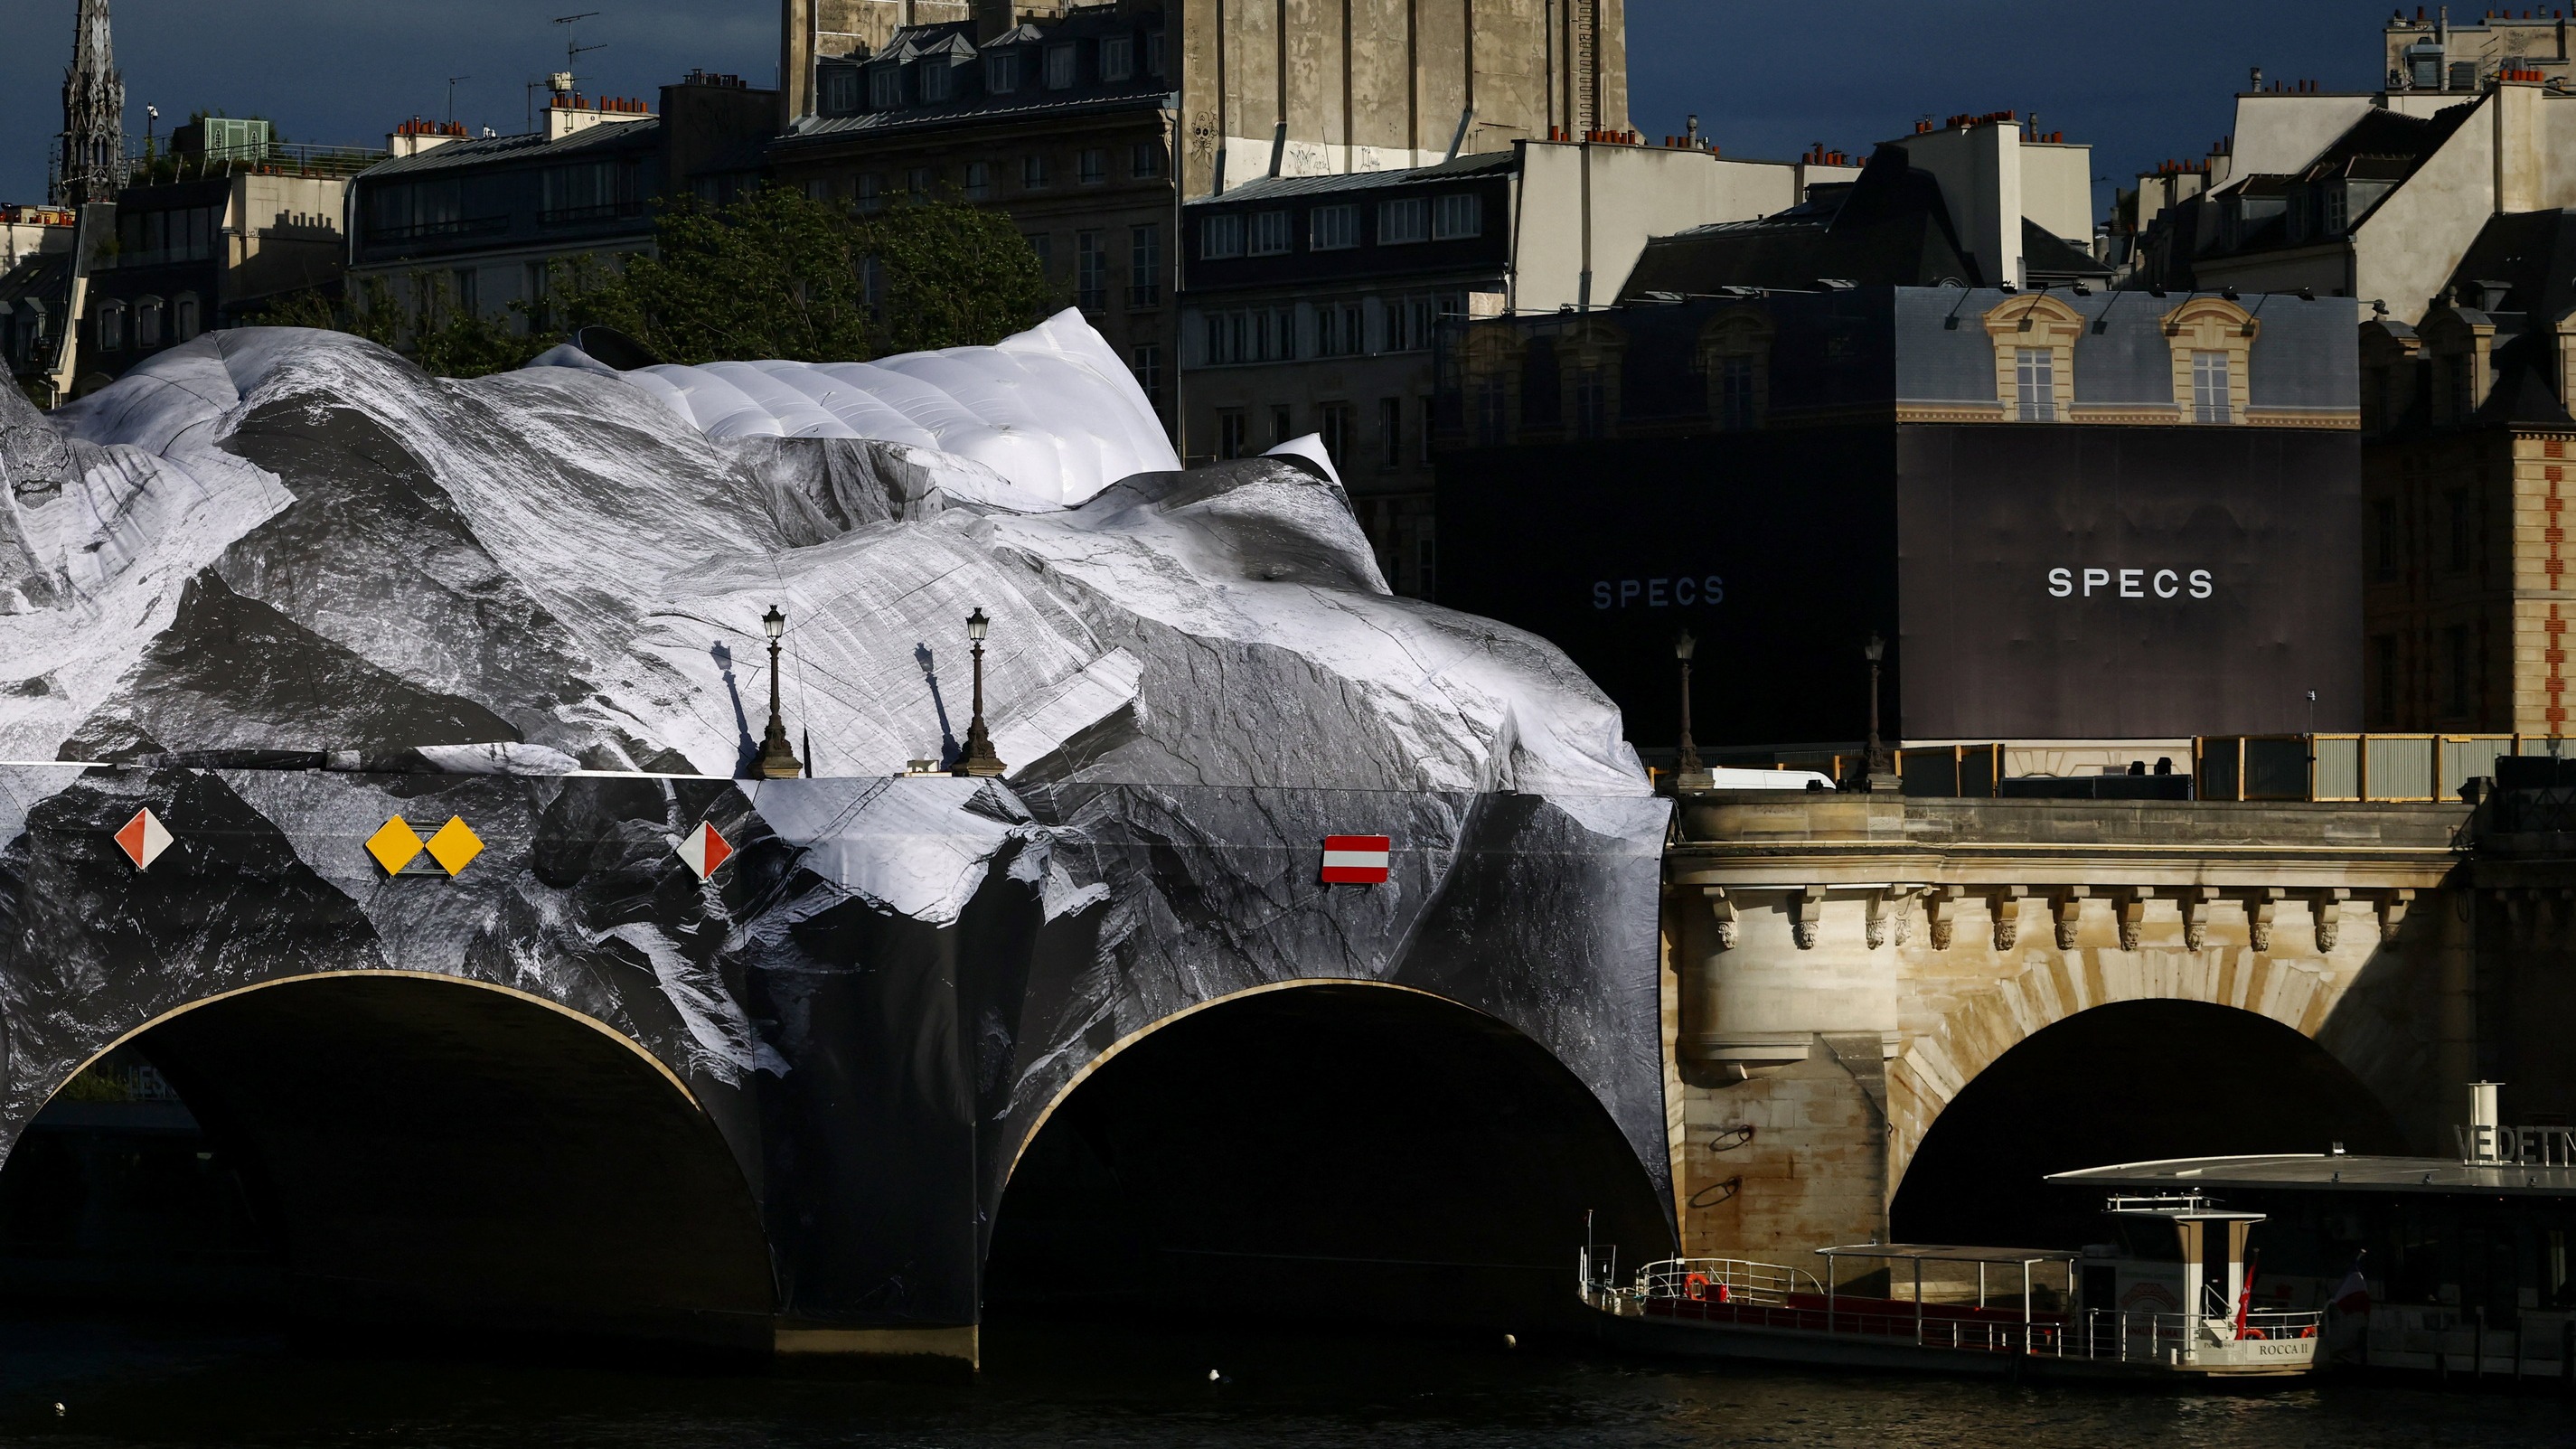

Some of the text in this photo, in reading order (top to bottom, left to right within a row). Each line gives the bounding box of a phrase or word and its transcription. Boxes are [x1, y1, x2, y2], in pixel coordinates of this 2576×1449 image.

[1594, 575, 1724, 609] SPECS
[2047, 568, 2214, 598] SPECS
[2453, 1124, 2576, 1163] VEDETT
[2260, 1343, 2308, 1355] ROCCA II
